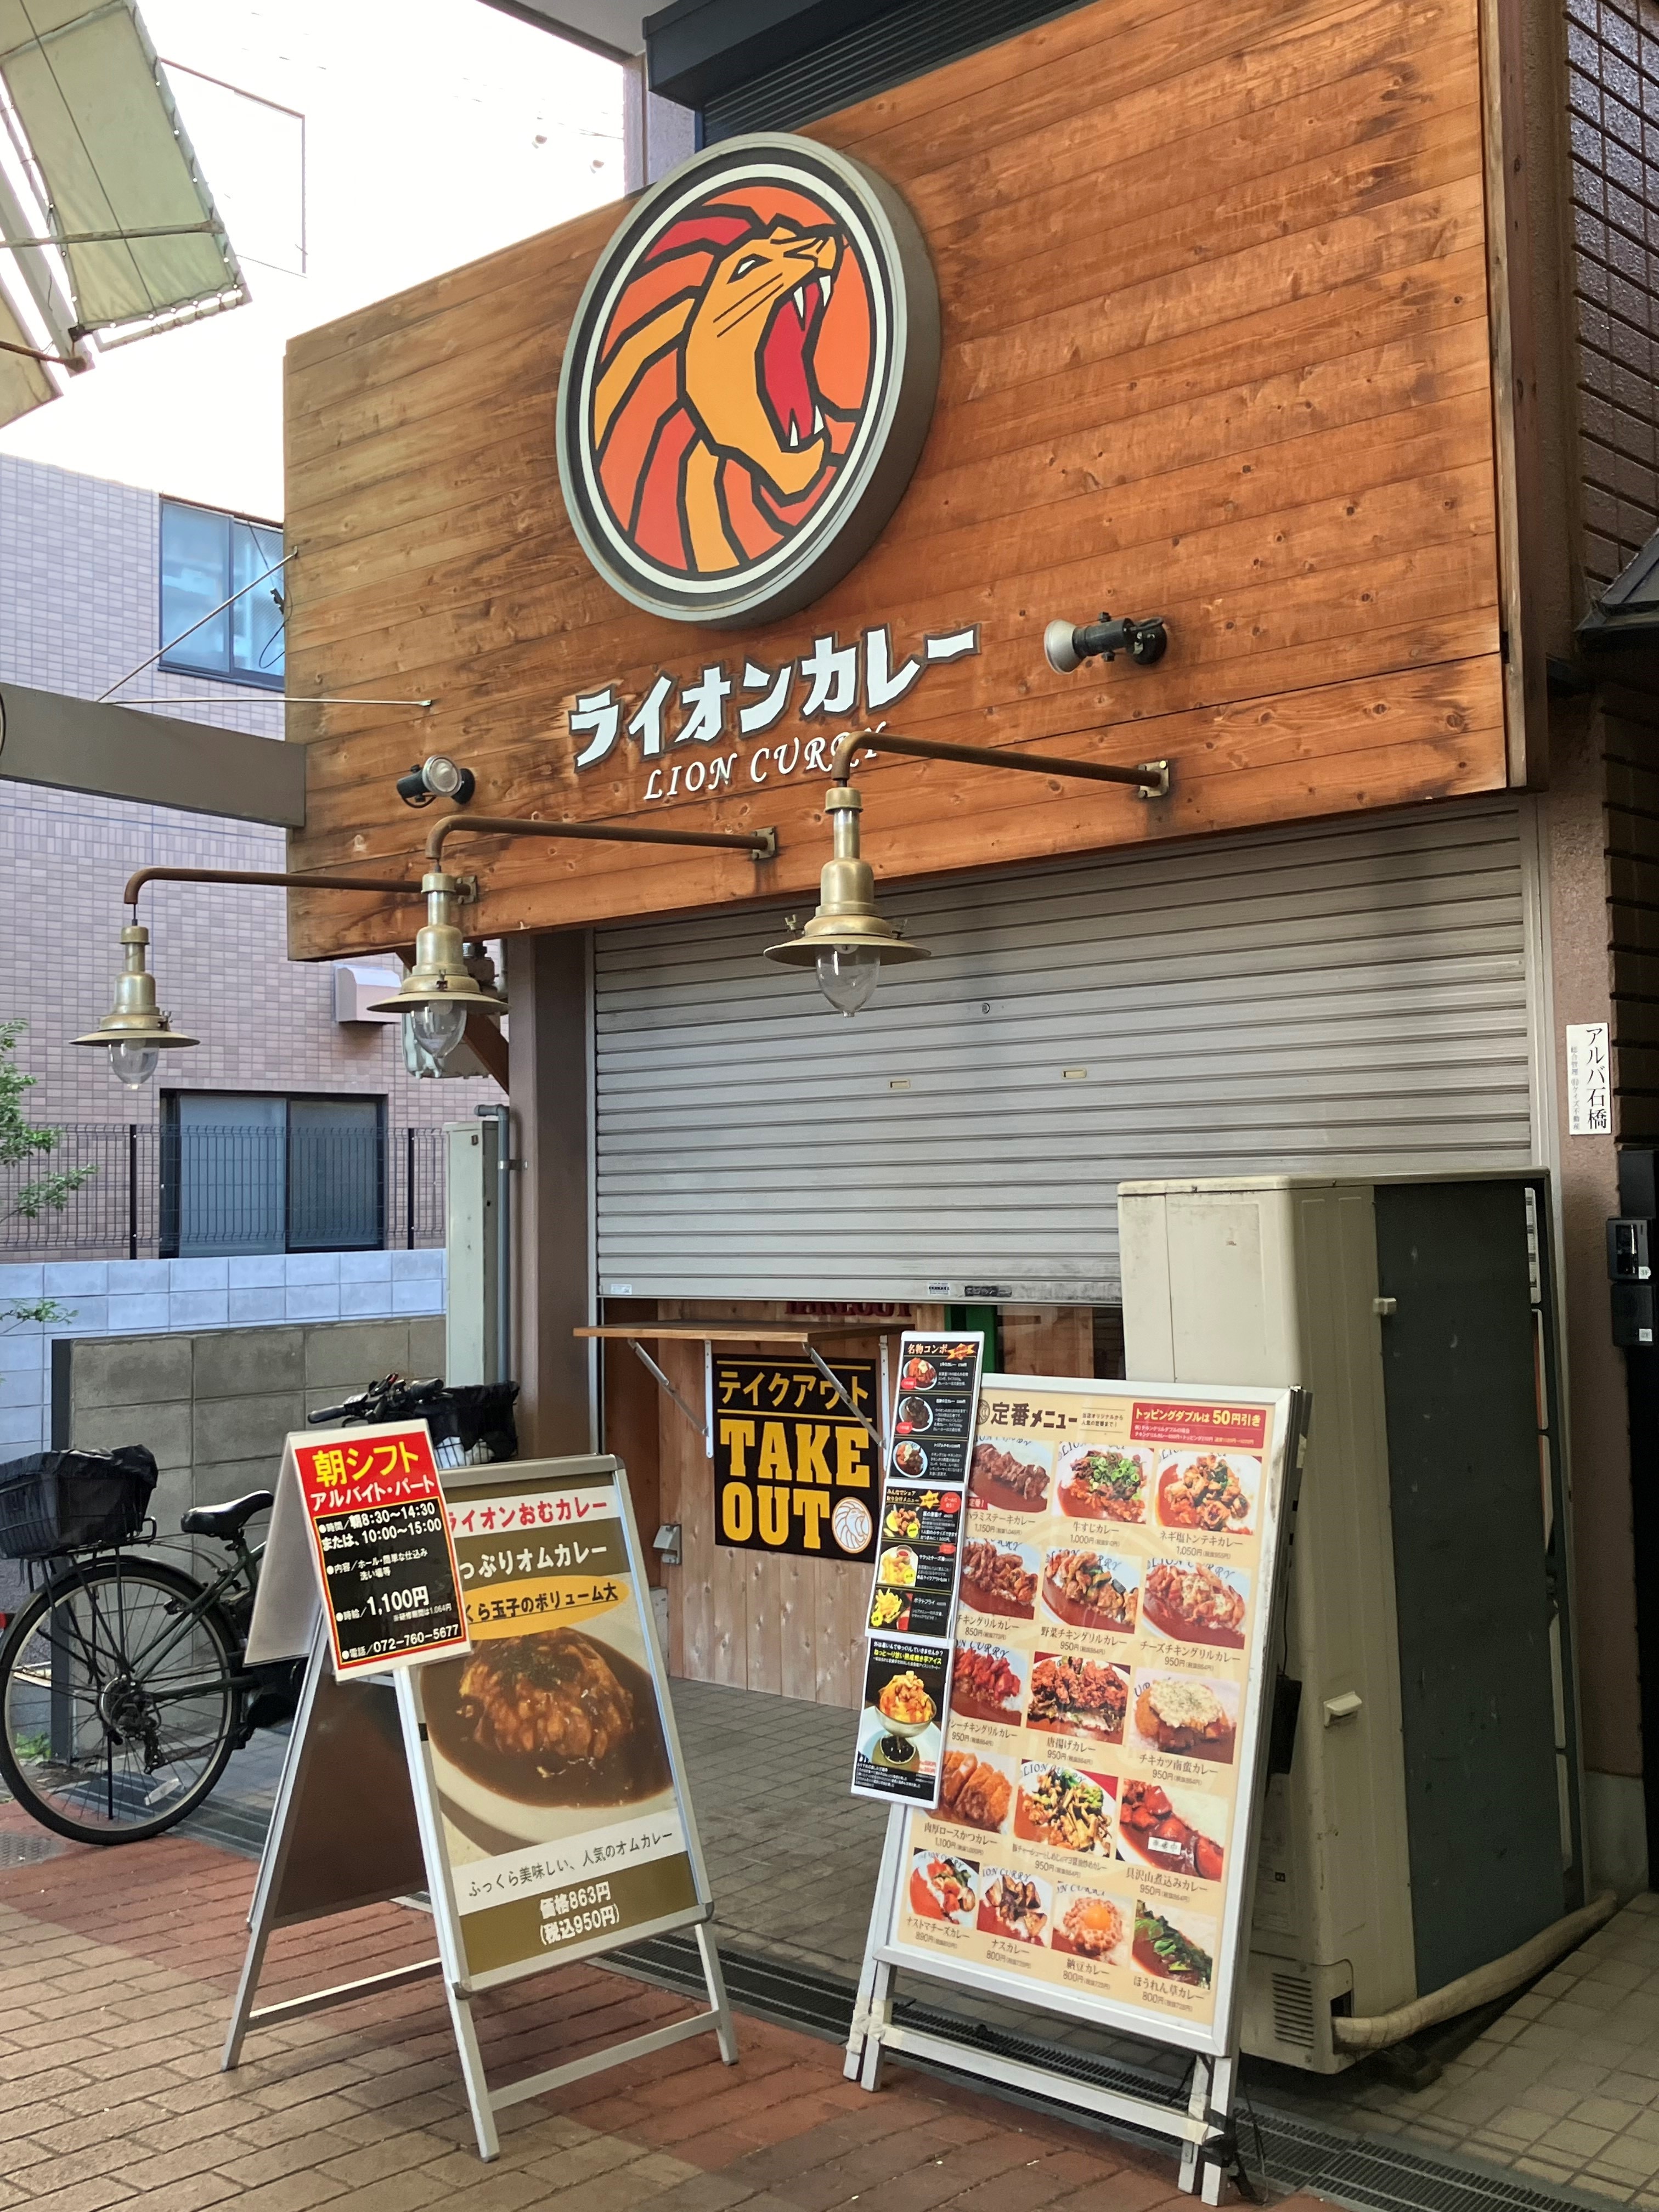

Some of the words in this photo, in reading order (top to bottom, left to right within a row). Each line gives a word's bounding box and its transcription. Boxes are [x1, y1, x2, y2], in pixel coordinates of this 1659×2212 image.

[569, 625, 978, 770] ライオンカレー
[643, 752, 738, 800] LION
[1586, 1028, 1607, 1130] アルバ石橋
[907, 1343, 948, 1355] 名物コンボ
[719, 1371, 869, 1410] テイクアウト
[990, 1402, 1077, 1429] 定番メニュー
[1135, 1407, 1210, 1423] トッピングダブルは
[1212, 1409, 1261, 1427] 50円引き
[312, 1441, 419, 1488] 朝シフト
[720, 1418, 871, 1488] TAKE
[311, 1474, 435, 1511] アルバイト・パート
[722, 1481, 830, 1549] OUT
[1073, 1521, 1119, 1534] 牛すじカレー
[1160, 1531, 1243, 1547] ネギ塩トンテキカレー
[459, 1541, 607, 1580] っぷりオムカレー
[1041, 1626, 1127, 1646] 野菜チキングリルカレー
[1140, 1640, 1241, 1663] チーズチキングリルカレー
[948, 1719, 1018, 1739] シーチキングリルカレー
[1046, 1736, 1096, 1753] 唐揚げカレー
[1139, 1753, 1218, 1775] チキカツ南蛮カレー
[924, 1822, 998, 1846] 肉厚ロースかつカレー
[468, 1831, 673, 1897] ふっくら美味しい、人気のオムカレー
[1125, 1866, 1208, 1893] 具沢山煮込みカレー
[539, 1881, 611, 1920] 価格863円
[906, 1916, 970, 1939] ナストマチーズカレー
[991, 1938, 1030, 1955] ナスカレー
[1066, 1957, 1110, 1976] 納豆カレー
[1133, 1975, 1204, 2001] ほうれん草カレー
